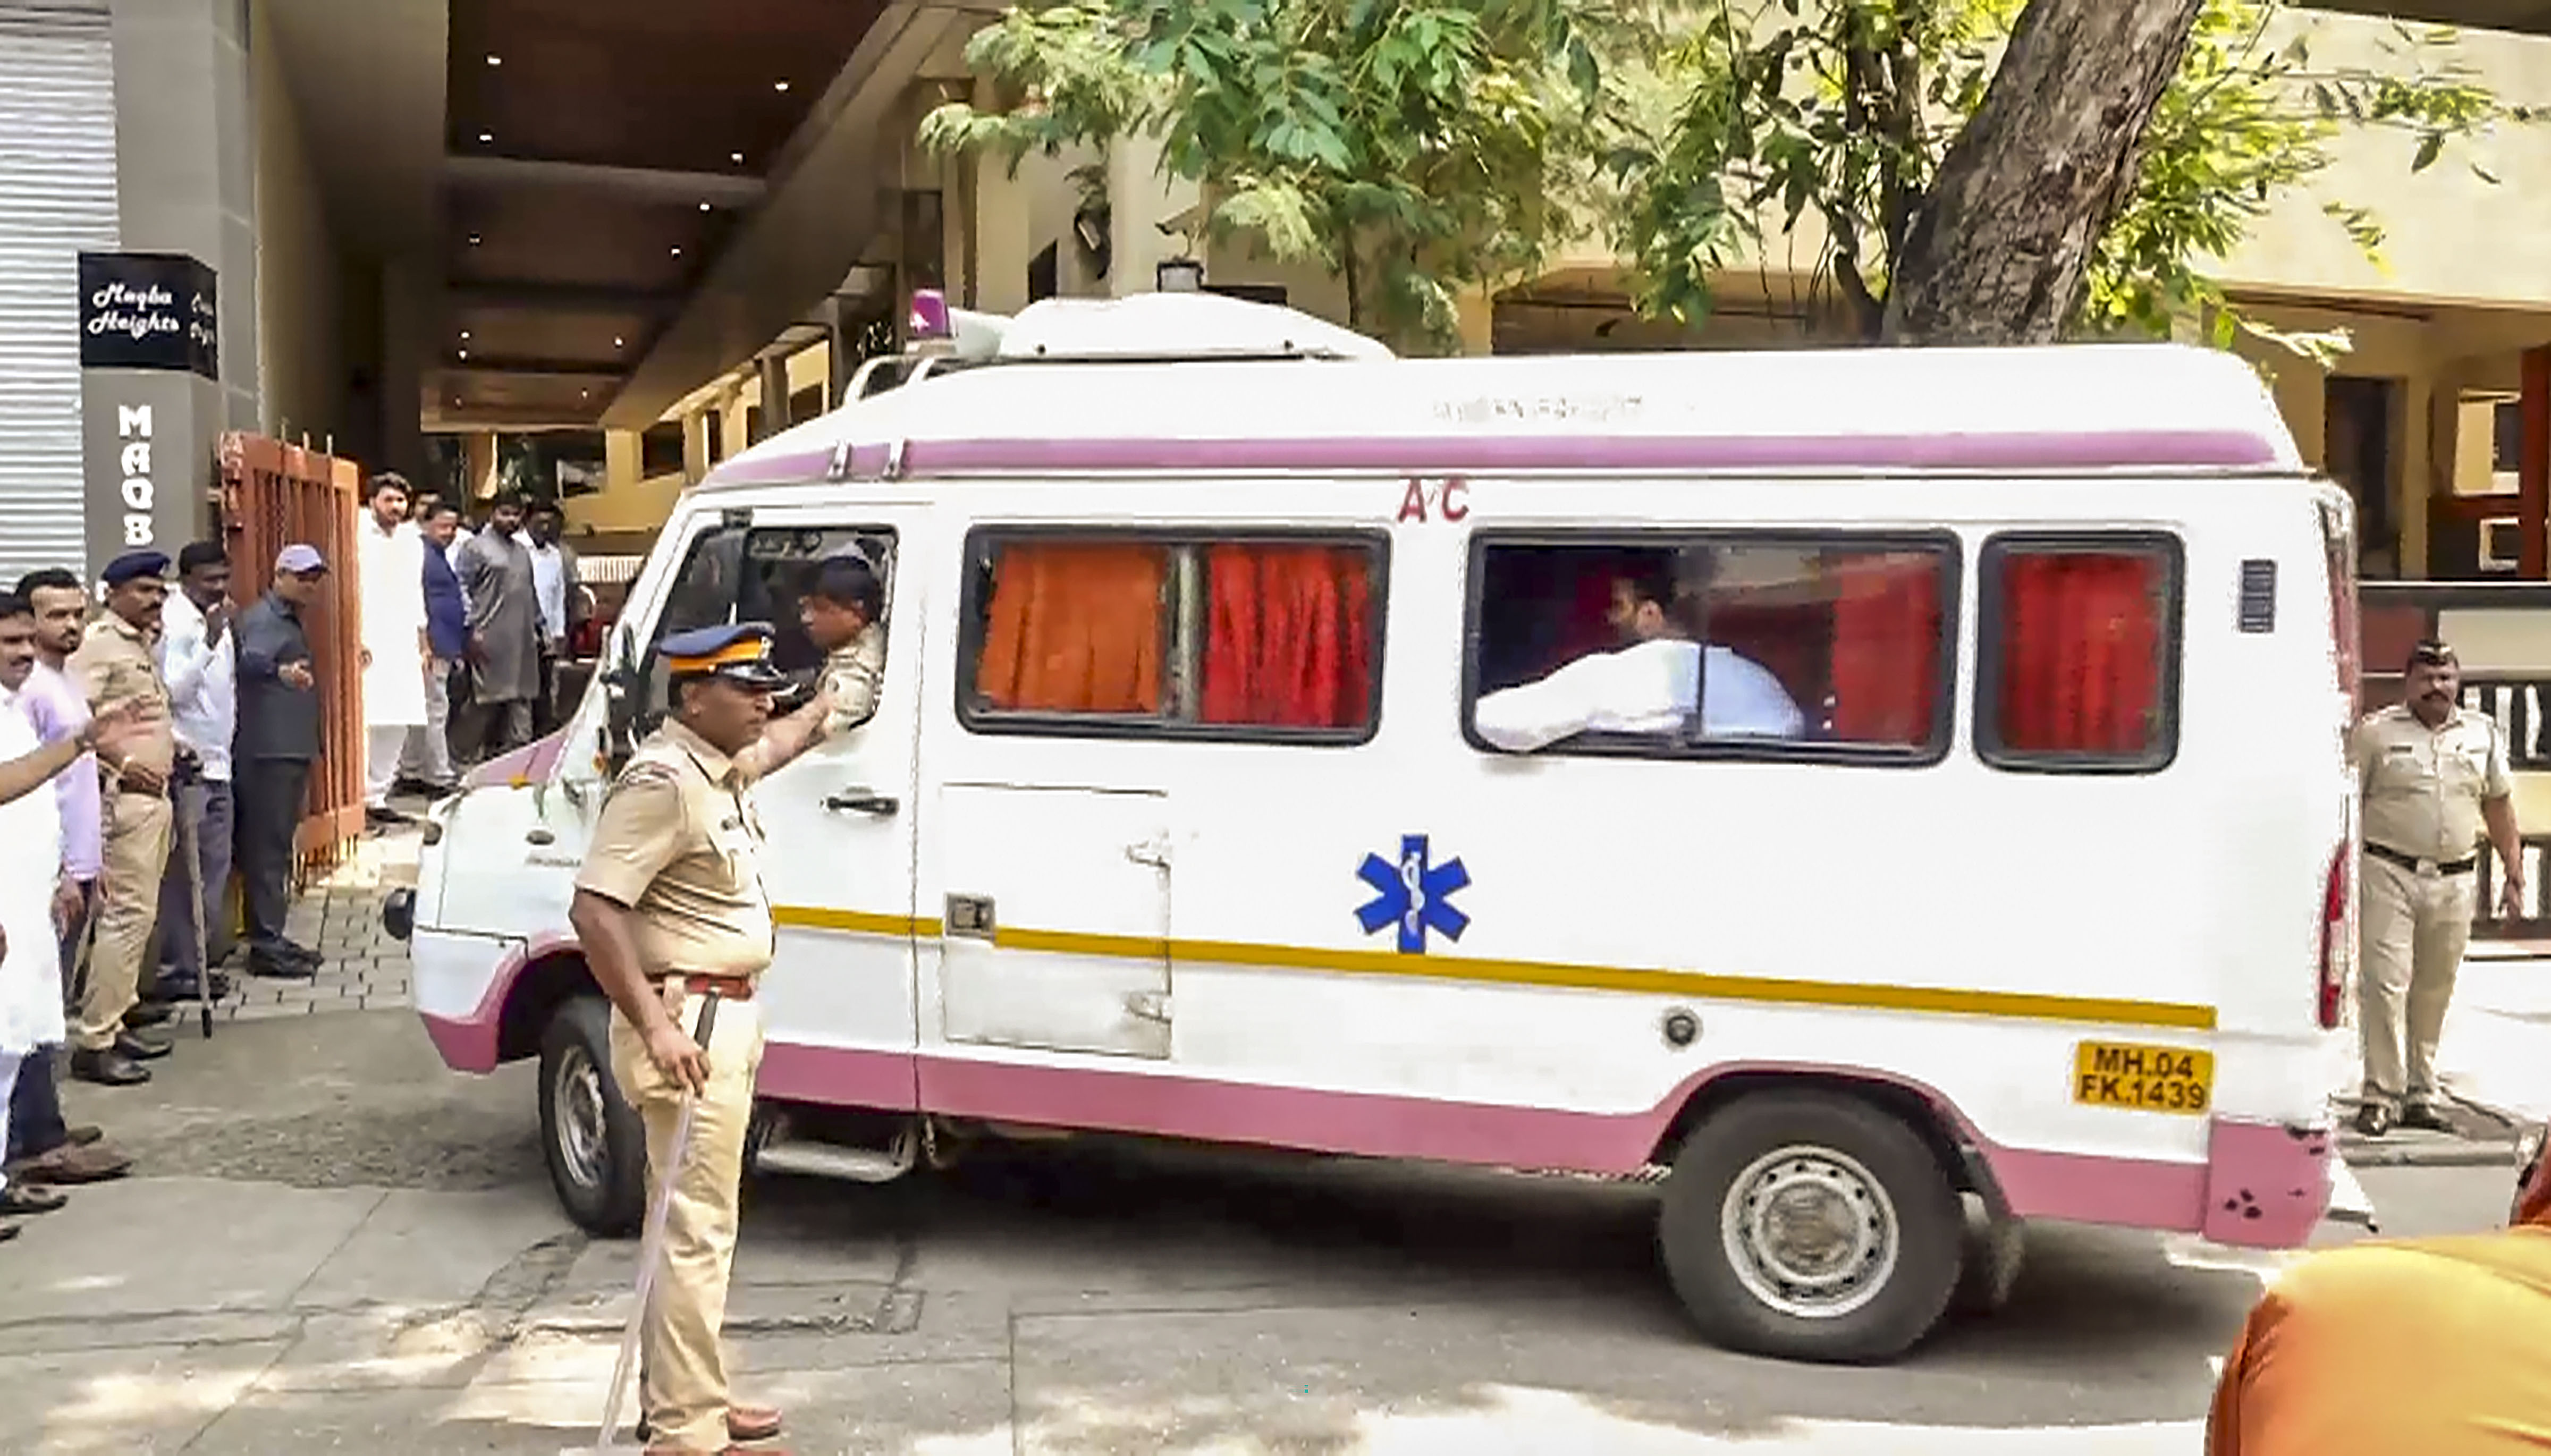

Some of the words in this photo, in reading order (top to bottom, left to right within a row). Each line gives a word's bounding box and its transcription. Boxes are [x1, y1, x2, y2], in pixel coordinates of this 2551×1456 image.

[87, 310, 180, 340] Heights
[2093, 1046, 2194, 1079] MH.04
[2080, 1074, 2206, 1110] FK.1439
